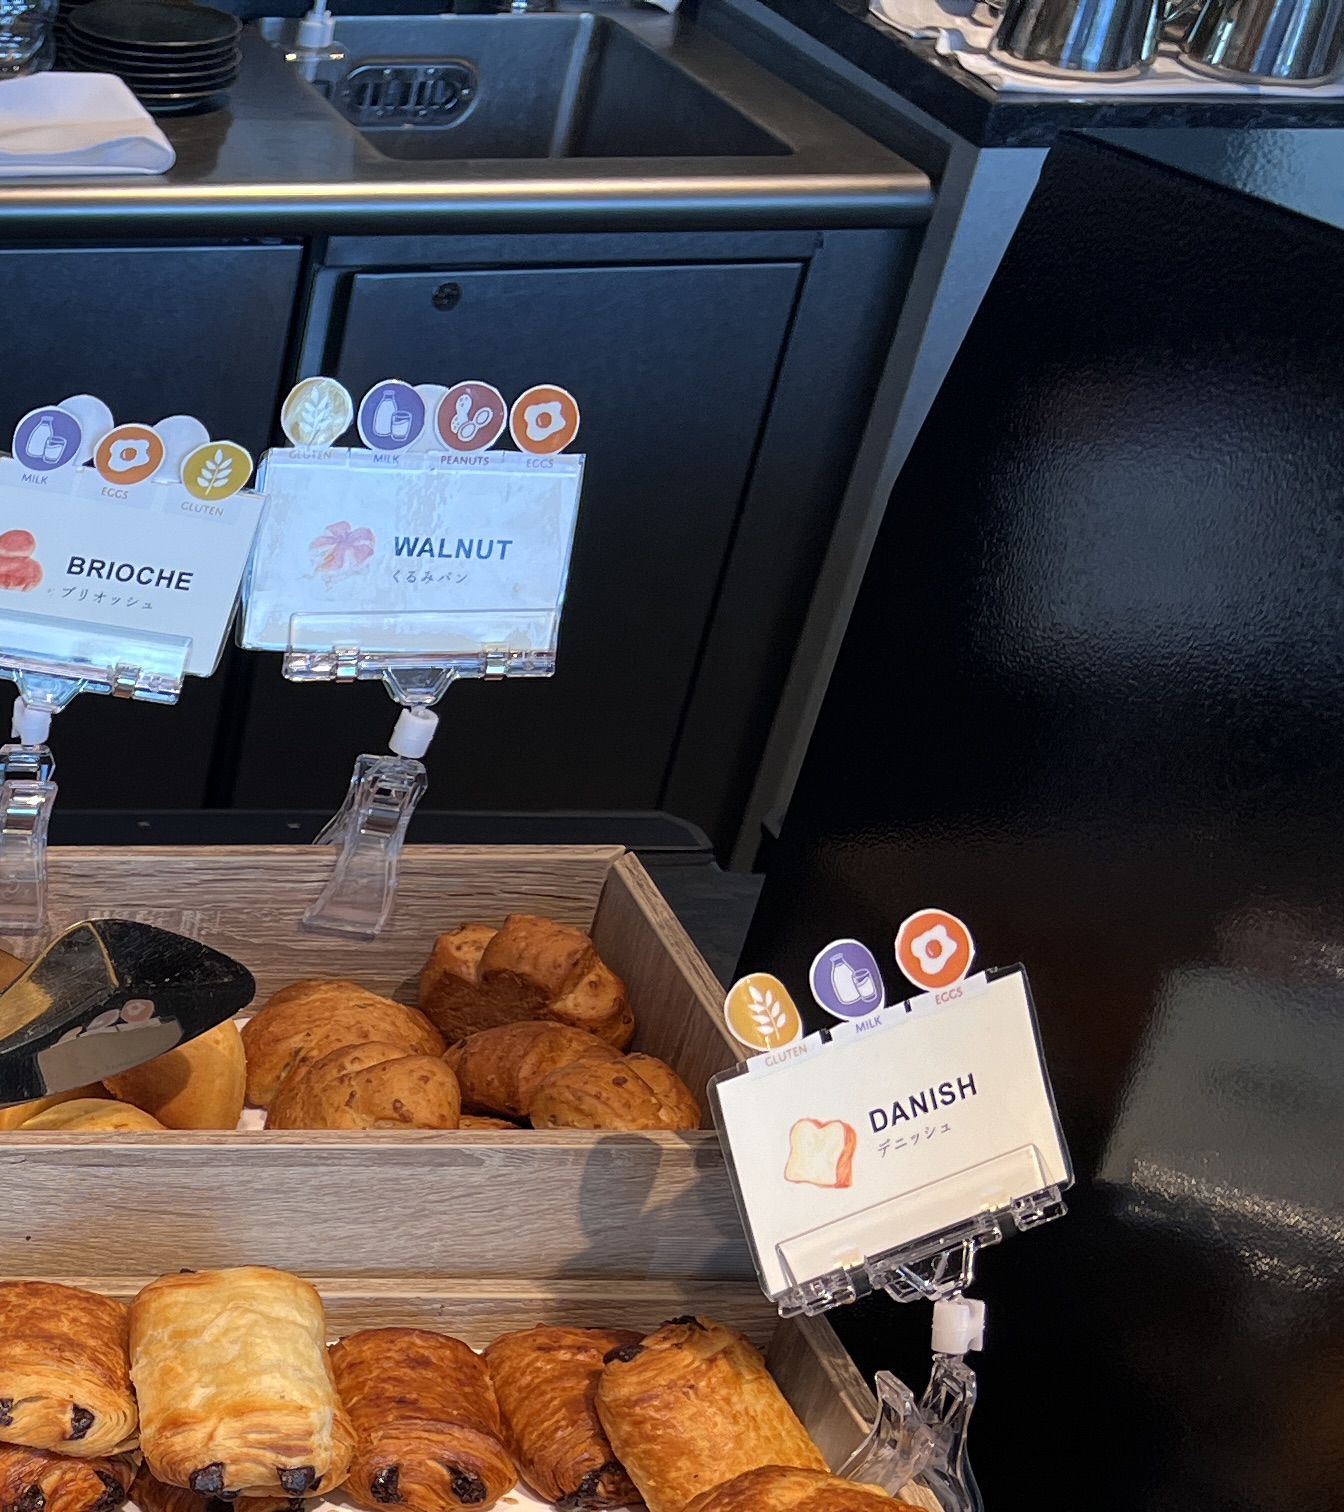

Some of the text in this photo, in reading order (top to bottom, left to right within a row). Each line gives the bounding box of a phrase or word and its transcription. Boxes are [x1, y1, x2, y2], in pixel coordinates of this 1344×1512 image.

[288, 449, 332, 460] GLUTEN
[373, 454, 400, 464] MILK
[440, 455, 490, 467] PEANUTS
[526, 458, 554, 469] EGGS
[22, 473, 48, 485] MILK
[101, 487, 129, 500] EGGS
[181, 501, 224, 517] GLUTEN
[394, 536, 513, 561] WALNUT
[66, 556, 194, 591] BRIOCHE
[392, 570, 469, 585] くるみパン
[934, 986, 963, 1006] EGGS
[855, 1015, 883, 1034] MILK
[765, 1044, 808, 1068] GLUTEN
[868, 1073, 978, 1133] DANISH
[877, 1122, 952, 1158] デニッシュ
